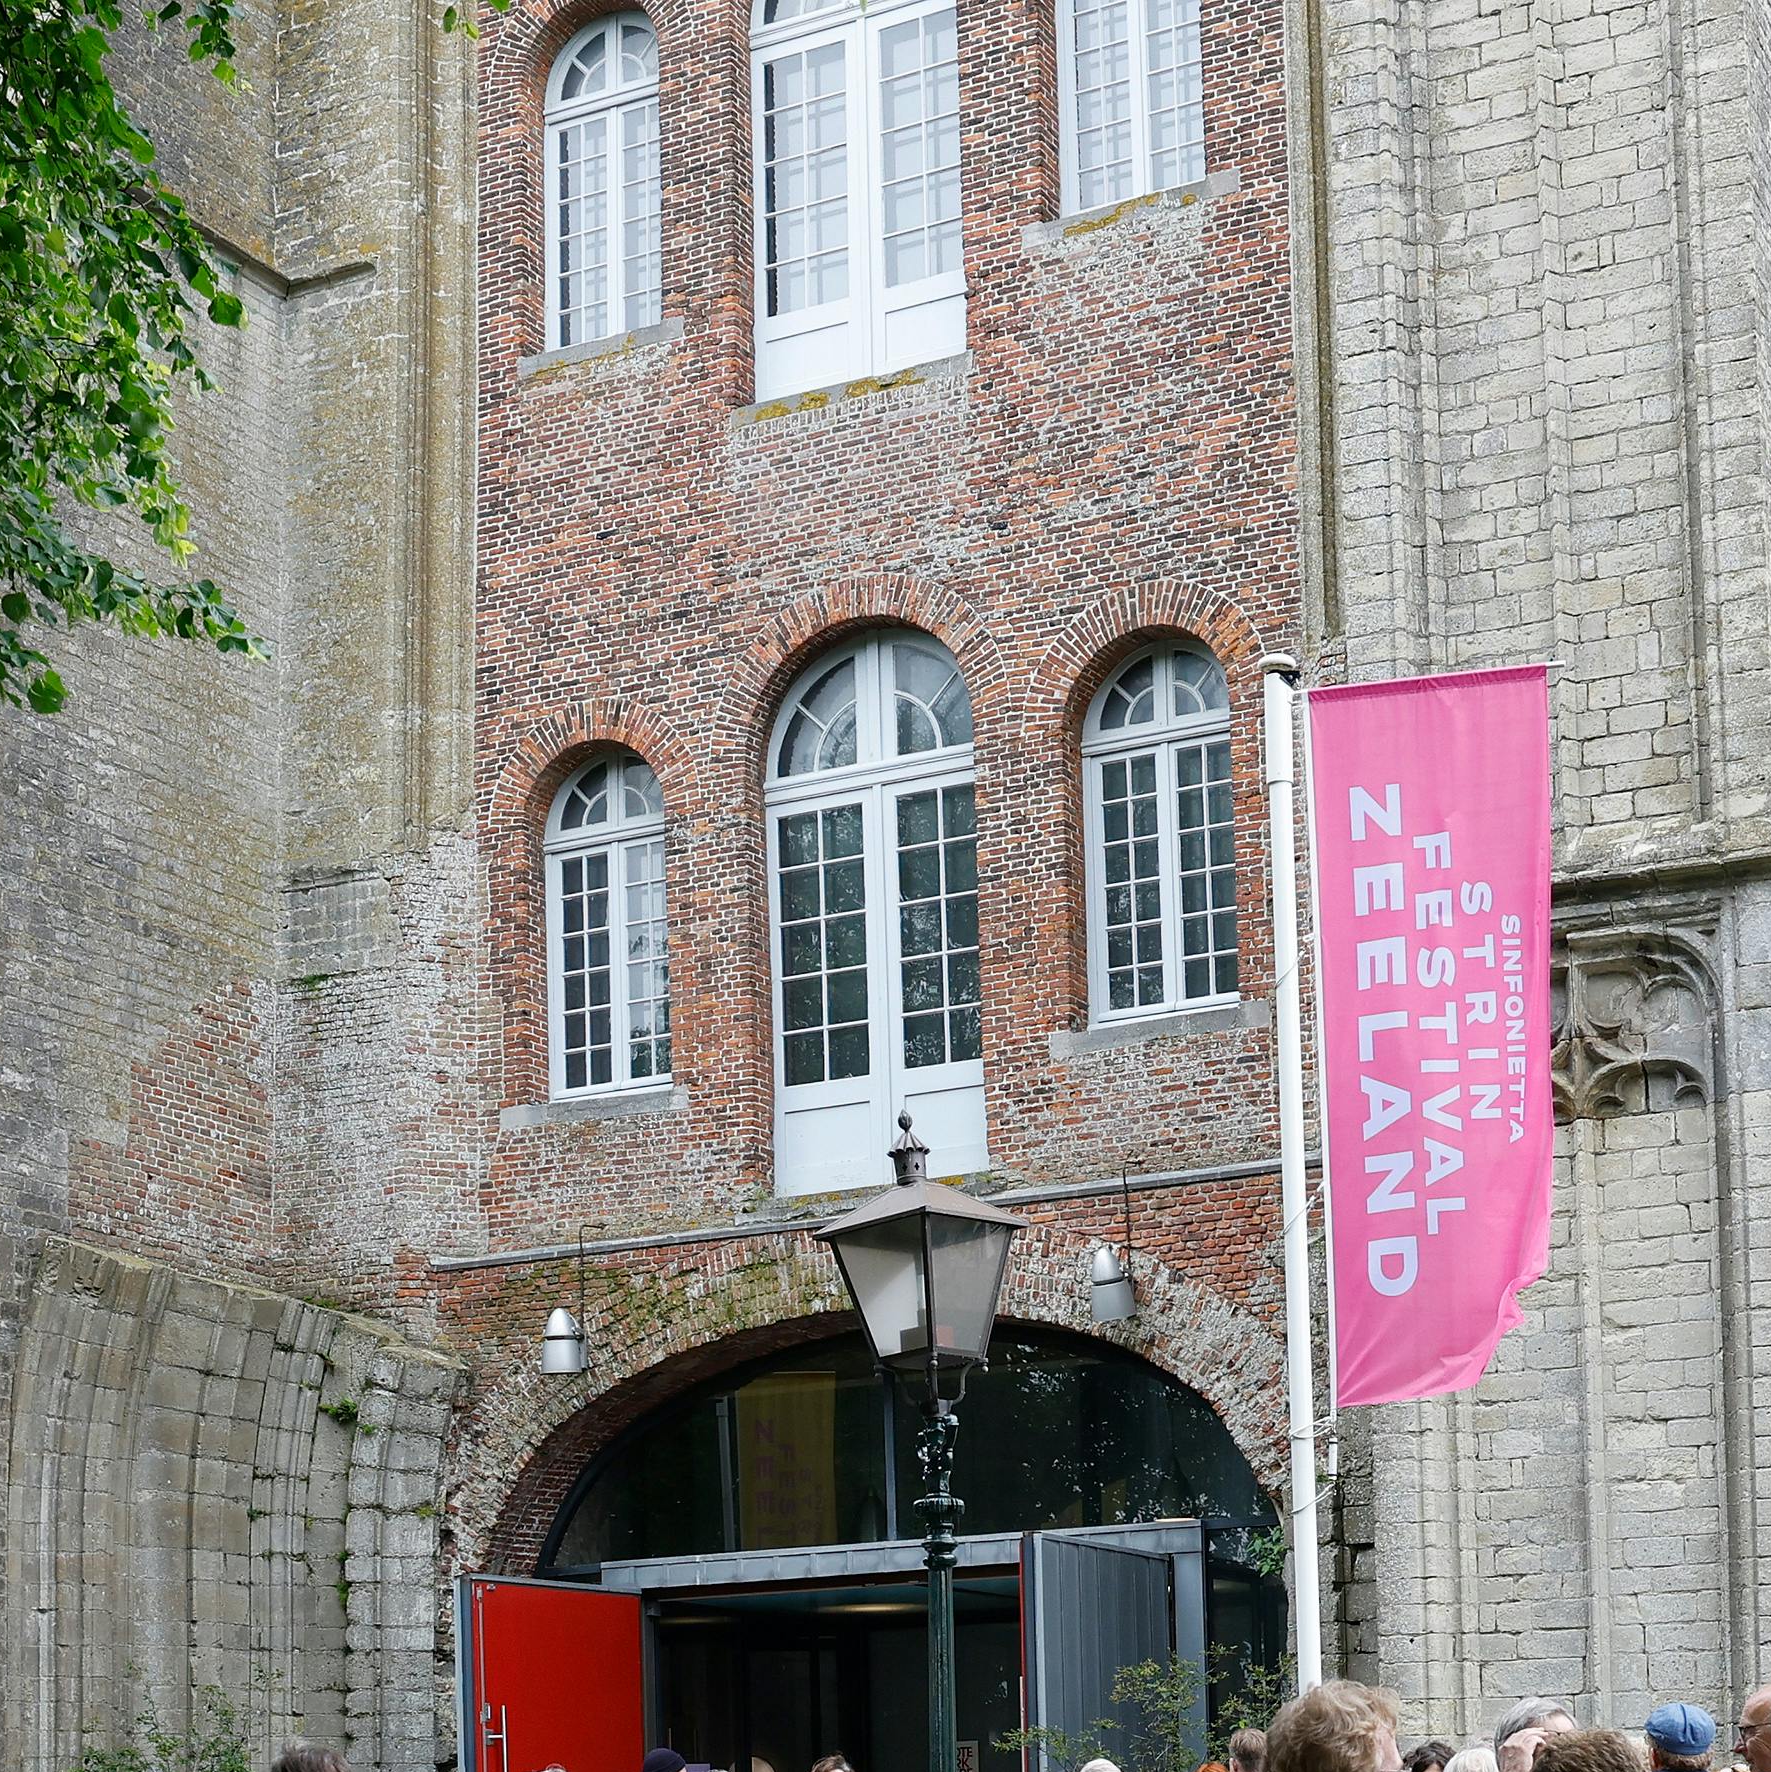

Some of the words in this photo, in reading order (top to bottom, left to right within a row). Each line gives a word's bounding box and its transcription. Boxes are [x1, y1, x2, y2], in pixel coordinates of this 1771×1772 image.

[1348, 783, 1419, 1297] ZEELAND
[1412, 831, 1466, 1235] FESTIVAL
[1459, 880, 1503, 1120] STRIN
[1500, 913, 1527, 1144] SINFONIETTA
